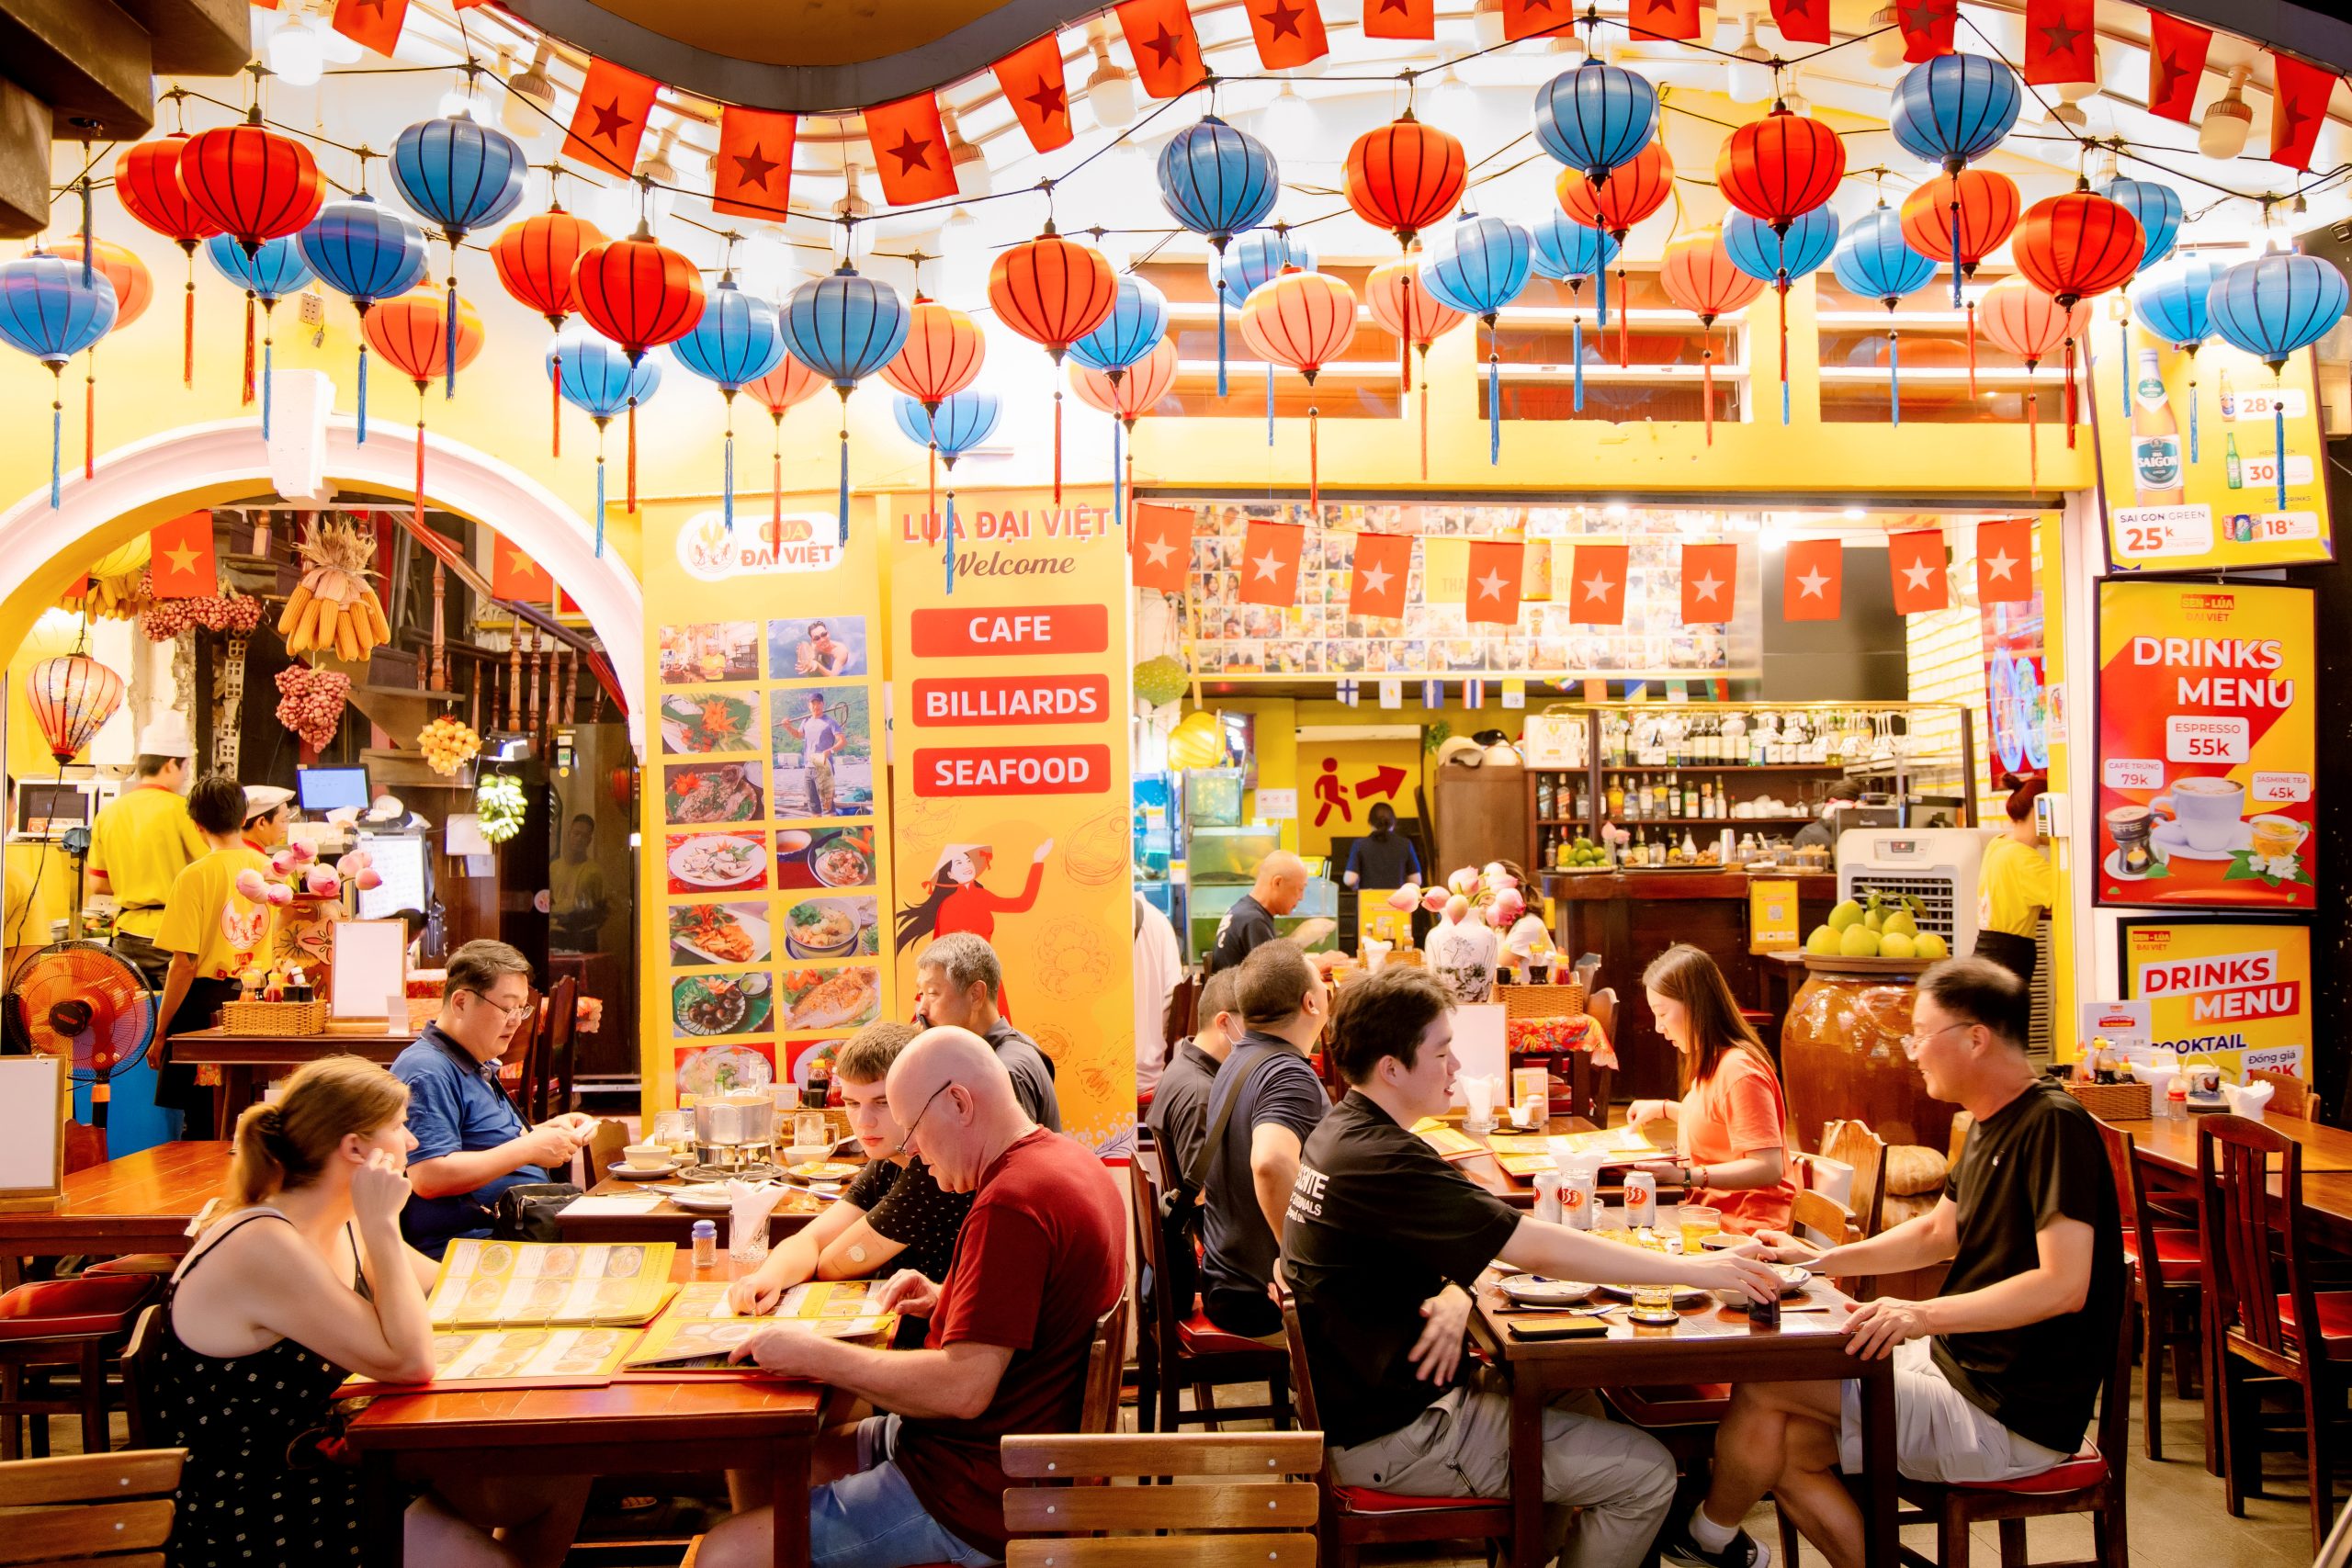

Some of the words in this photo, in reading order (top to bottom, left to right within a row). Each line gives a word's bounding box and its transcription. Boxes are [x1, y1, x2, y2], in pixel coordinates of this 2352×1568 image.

[2138, 457, 2177, 468] SAIGON
[975, 510, 1031, 544] ĐẠI
[1040, 502, 1112, 541] VIỆT
[2141, 513, 2165, 522] GON
[2168, 511, 2206, 520] GREEN
[784, 541, 834, 568] VIỆT
[942, 551, 1077, 578] Welcome
[968, 615, 1052, 643] CAFE
[2133, 637, 2283, 670] DRINKS
[926, 687, 1098, 717] BILLIARDS
[2177, 676, 2294, 708] MENU
[2175, 723, 2241, 734] ESPRESSO
[2188, 738, 2230, 757] 55k
[934, 757, 1090, 786] SEAFOOD
[2121, 773, 2148, 785] 79k
[2256, 775, 2290, 784] JASMINE
[2268, 786, 2296, 798] 45k
[2145, 957, 2270, 993] DRINKS
[2193, 987, 2293, 1021] MENU
